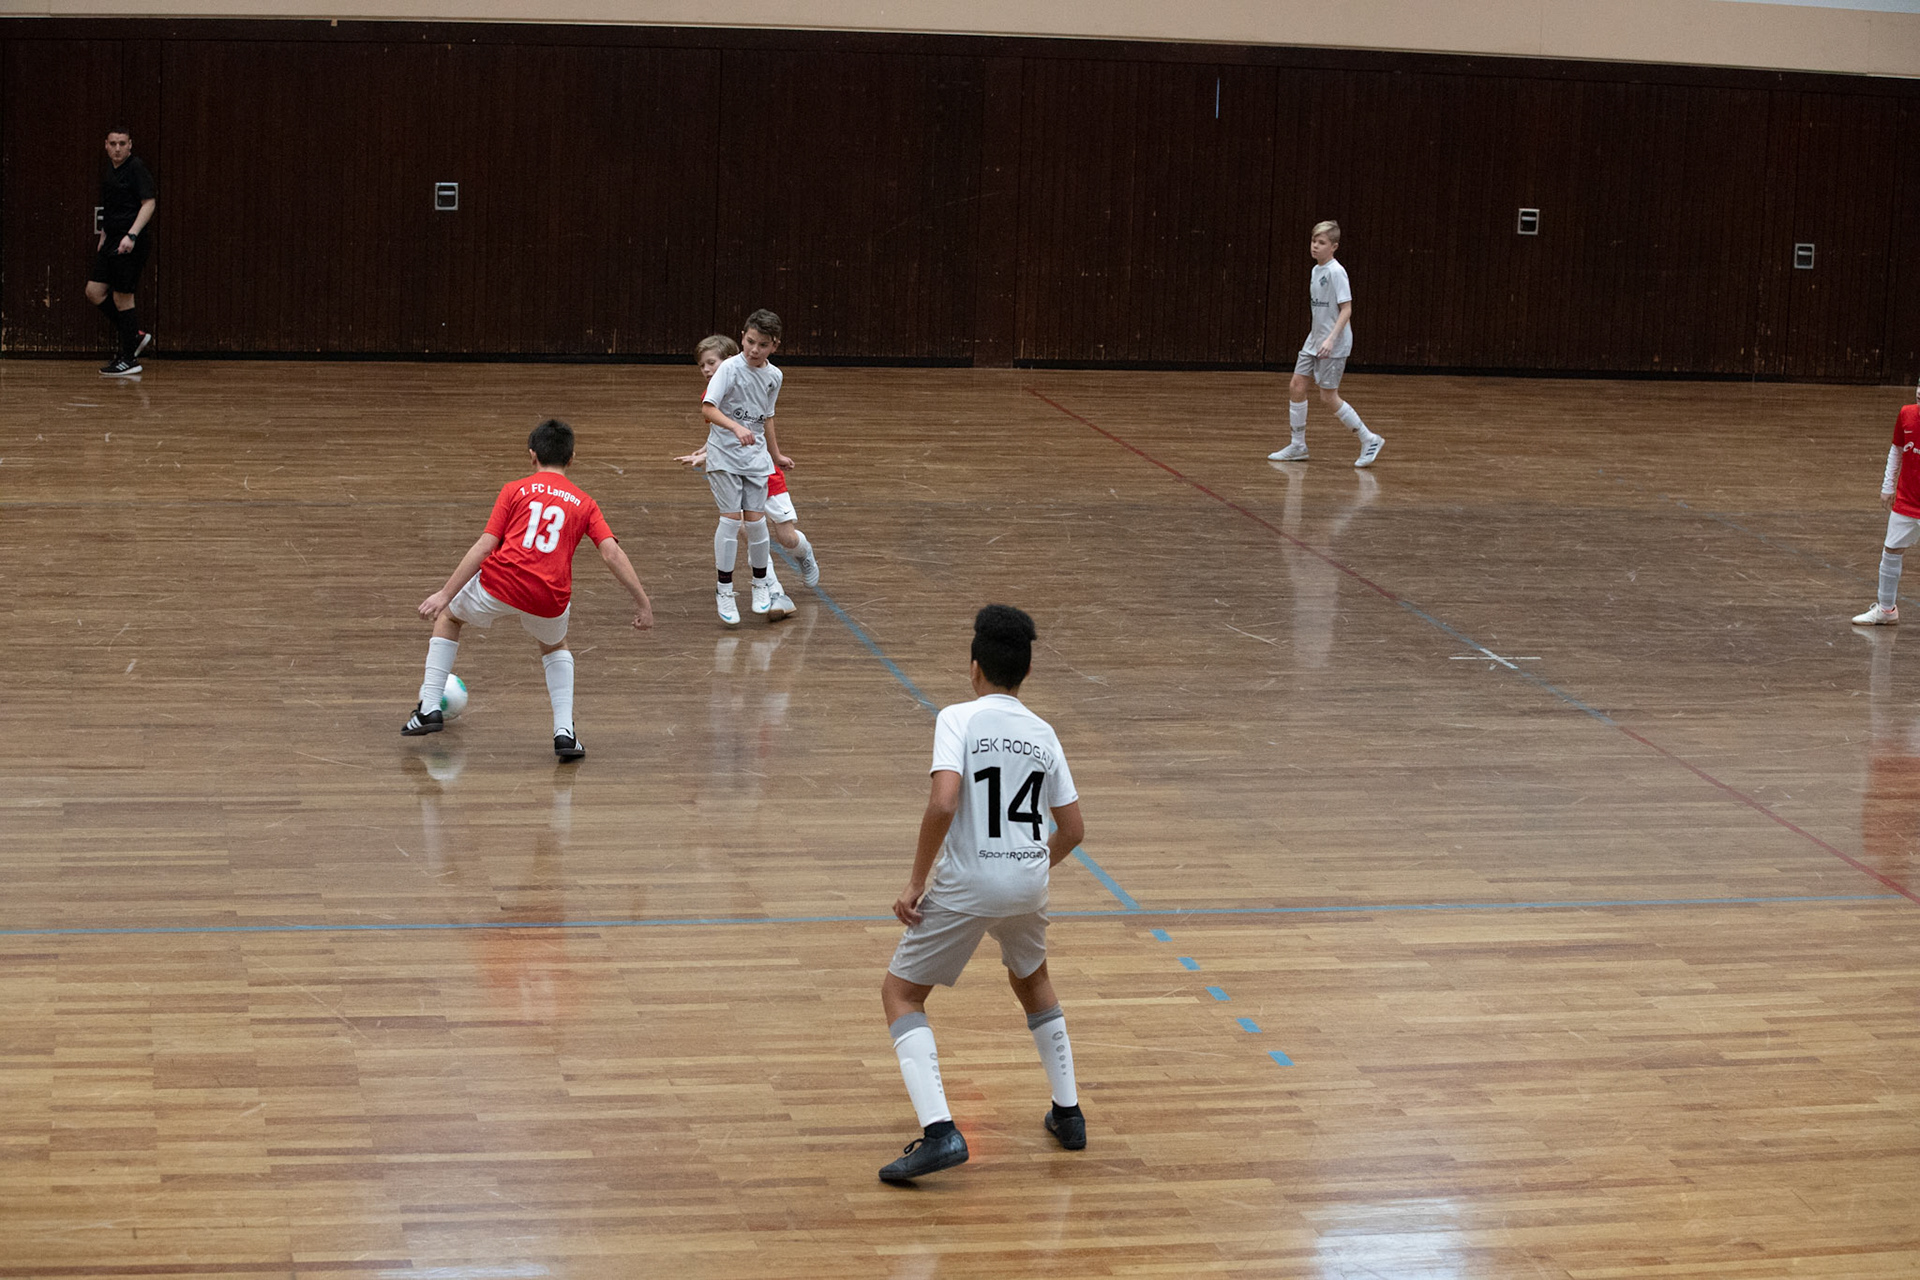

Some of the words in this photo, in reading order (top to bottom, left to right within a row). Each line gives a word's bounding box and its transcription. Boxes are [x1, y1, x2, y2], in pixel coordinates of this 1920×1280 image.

[520, 487, 529, 496] 1.
[531, 483, 545, 493] FC
[547, 485, 581, 507] Langen
[522, 500, 566, 554] 13
[972, 738, 999, 754] JSK
[974, 766, 1045, 841] 14
